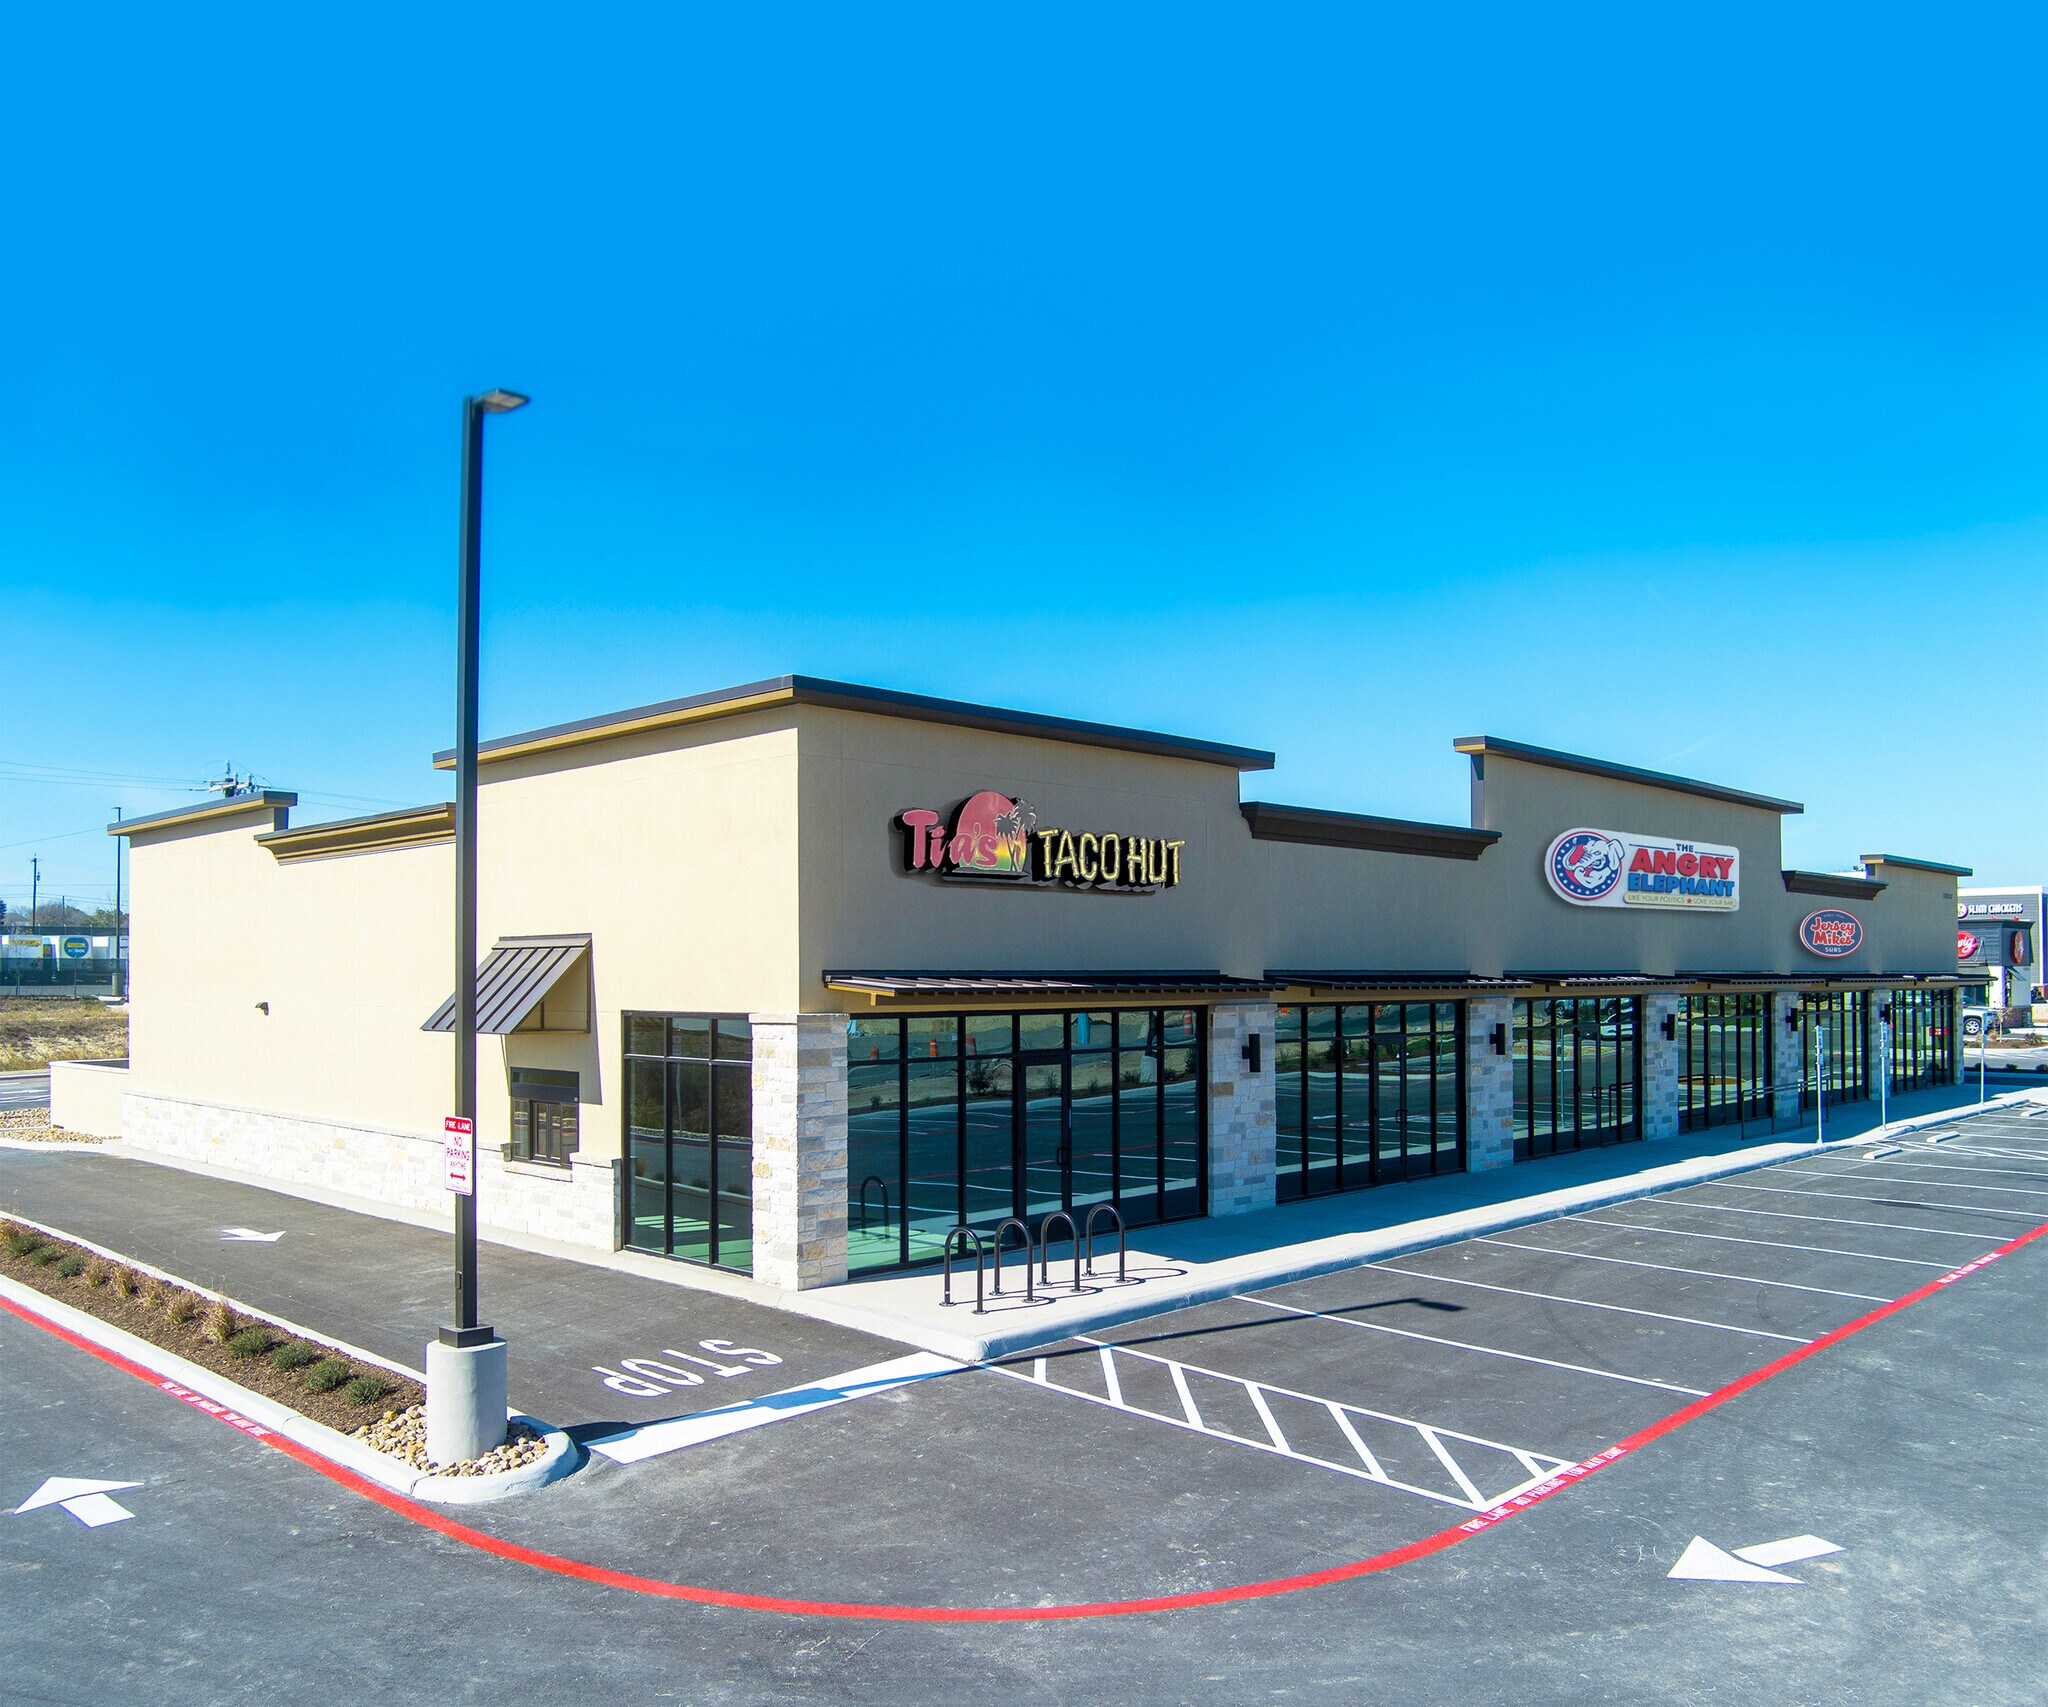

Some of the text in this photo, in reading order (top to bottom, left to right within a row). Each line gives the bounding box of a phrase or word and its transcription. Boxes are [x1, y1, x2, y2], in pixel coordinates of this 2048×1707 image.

[902, 809, 1187, 886] Tia's TACO HUT
[1676, 843, 1694, 853] THE
[1629, 848, 1735, 880] ANGRY
[1628, 872, 1735, 897] ELEPHANT
[1641, 895, 1659, 903] YOUR
[1660, 896, 1685, 904] POLITICS
[1968, 903, 1988, 914] SLIM
[1811, 917, 1855, 937] Jersey
[445, 1120, 471, 1132] FIRE LANE
[453, 1136, 463, 1147] NO
[446, 1147, 471, 1161] PARKING
[591, 1339, 784, 1398] STOP
[1459, 1518, 1489, 1533] FIRE
[1480, 1505, 1514, 1522] LANE
[1510, 1496, 1533, 1506] NO
[1525, 1478, 1567, 1498] PARKING
[1599, 1446, 1628, 1460] ZONE
